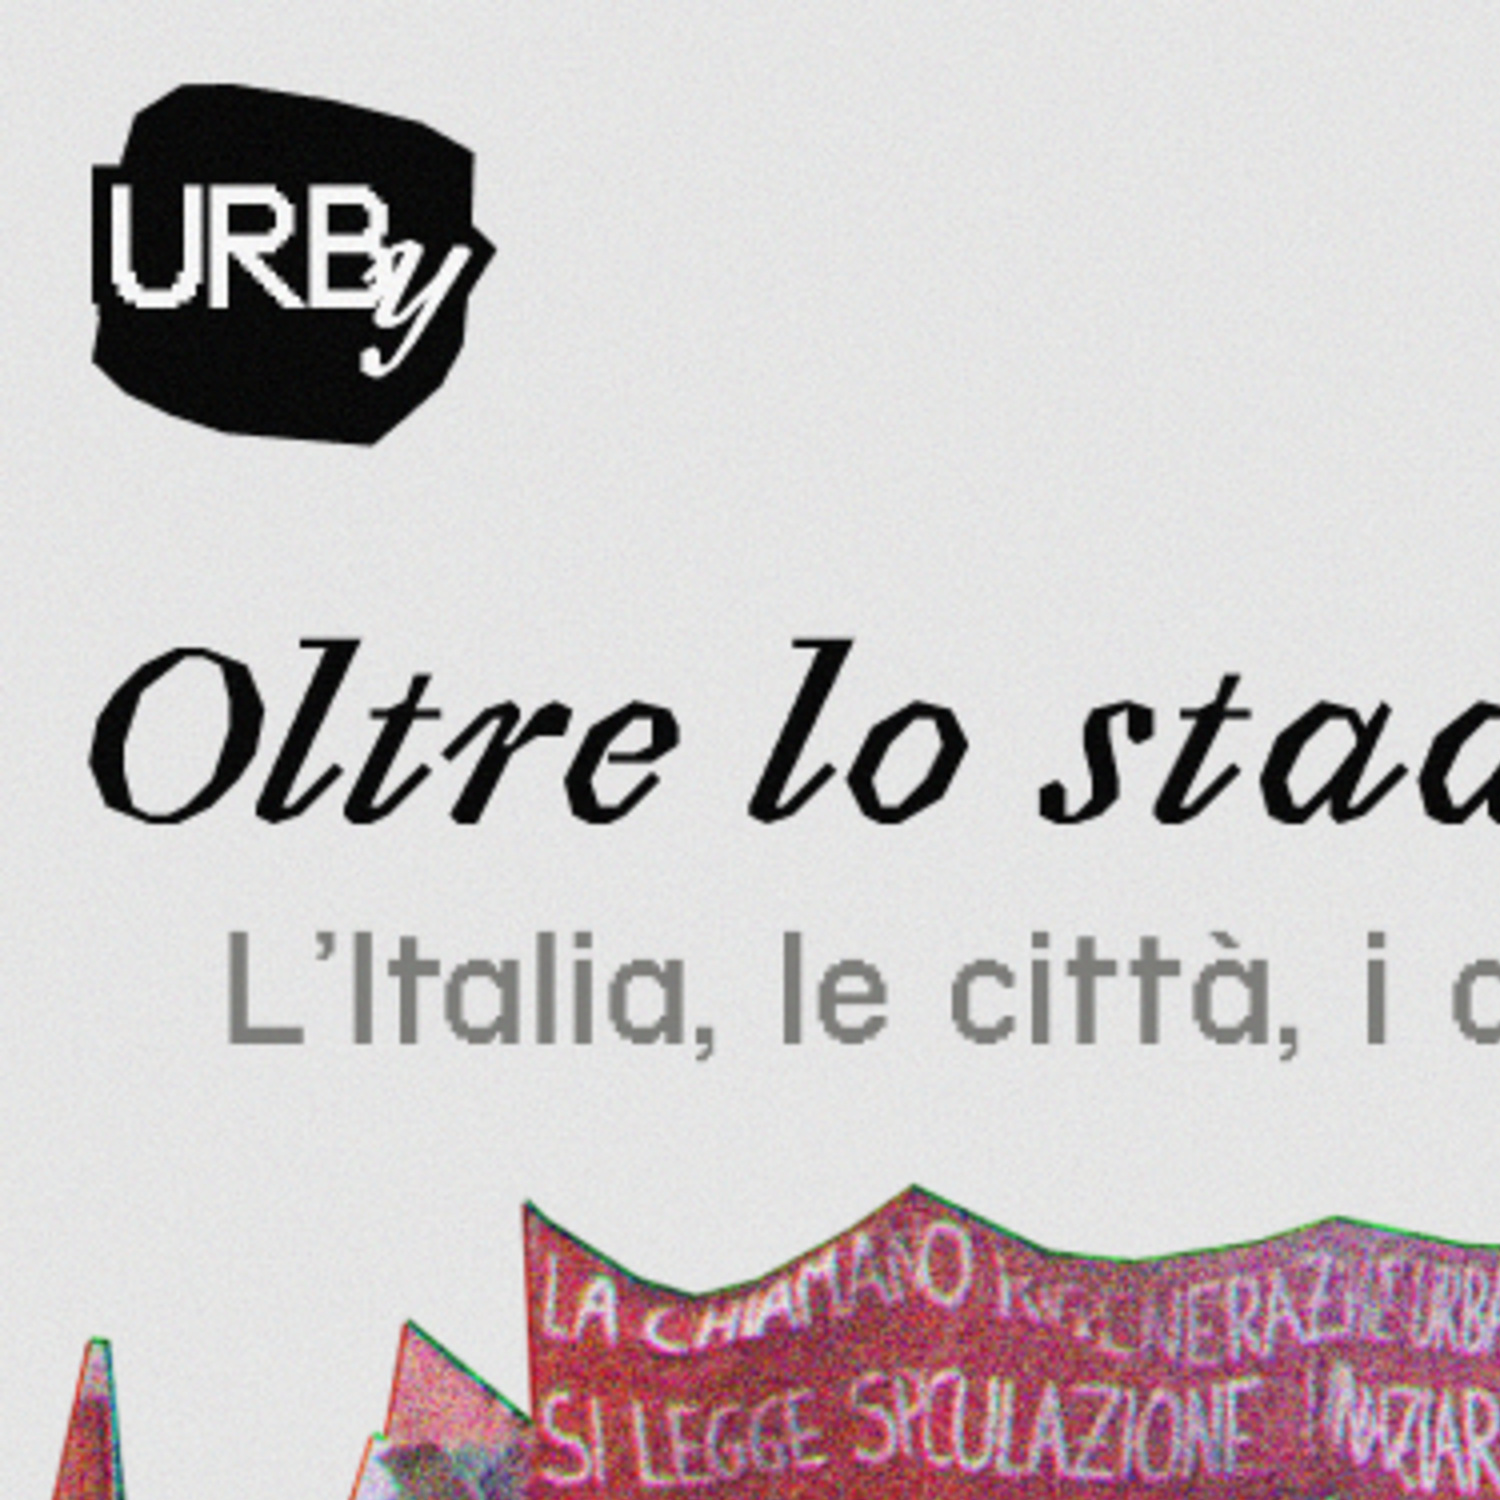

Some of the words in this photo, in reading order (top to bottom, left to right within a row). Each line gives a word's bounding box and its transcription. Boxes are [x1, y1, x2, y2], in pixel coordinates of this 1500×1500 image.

[541, 1250, 619, 1347] LA
[540, 1390, 606, 1485] SI
[631, 1388, 829, 1487] LEGGE
